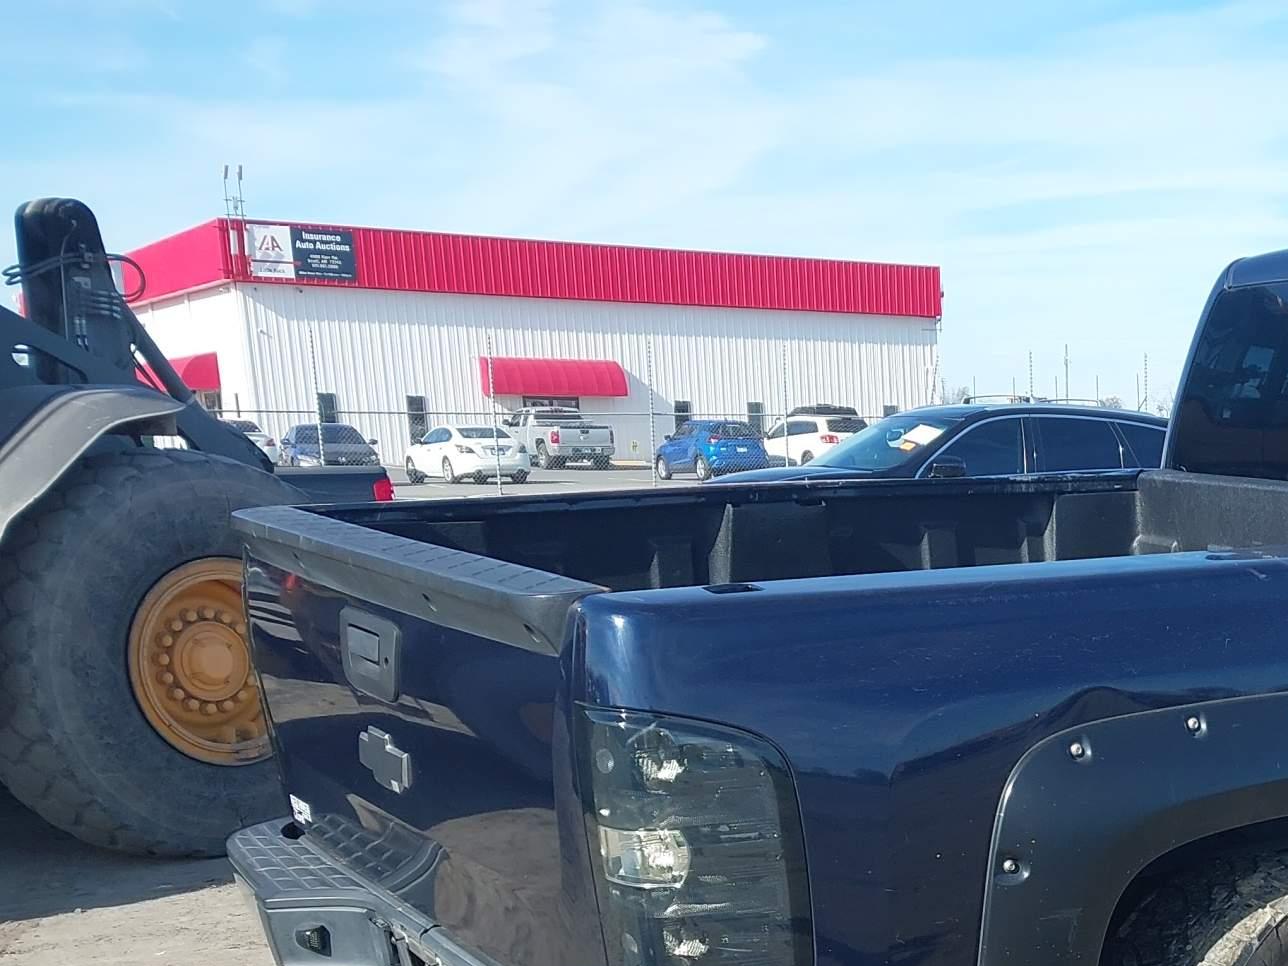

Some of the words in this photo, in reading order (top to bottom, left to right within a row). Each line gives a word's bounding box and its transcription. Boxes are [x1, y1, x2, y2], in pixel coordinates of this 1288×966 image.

[302, 231, 341, 241] Insurance
[296, 240, 314, 248] Auto
[315, 241, 350, 251] Auctions
